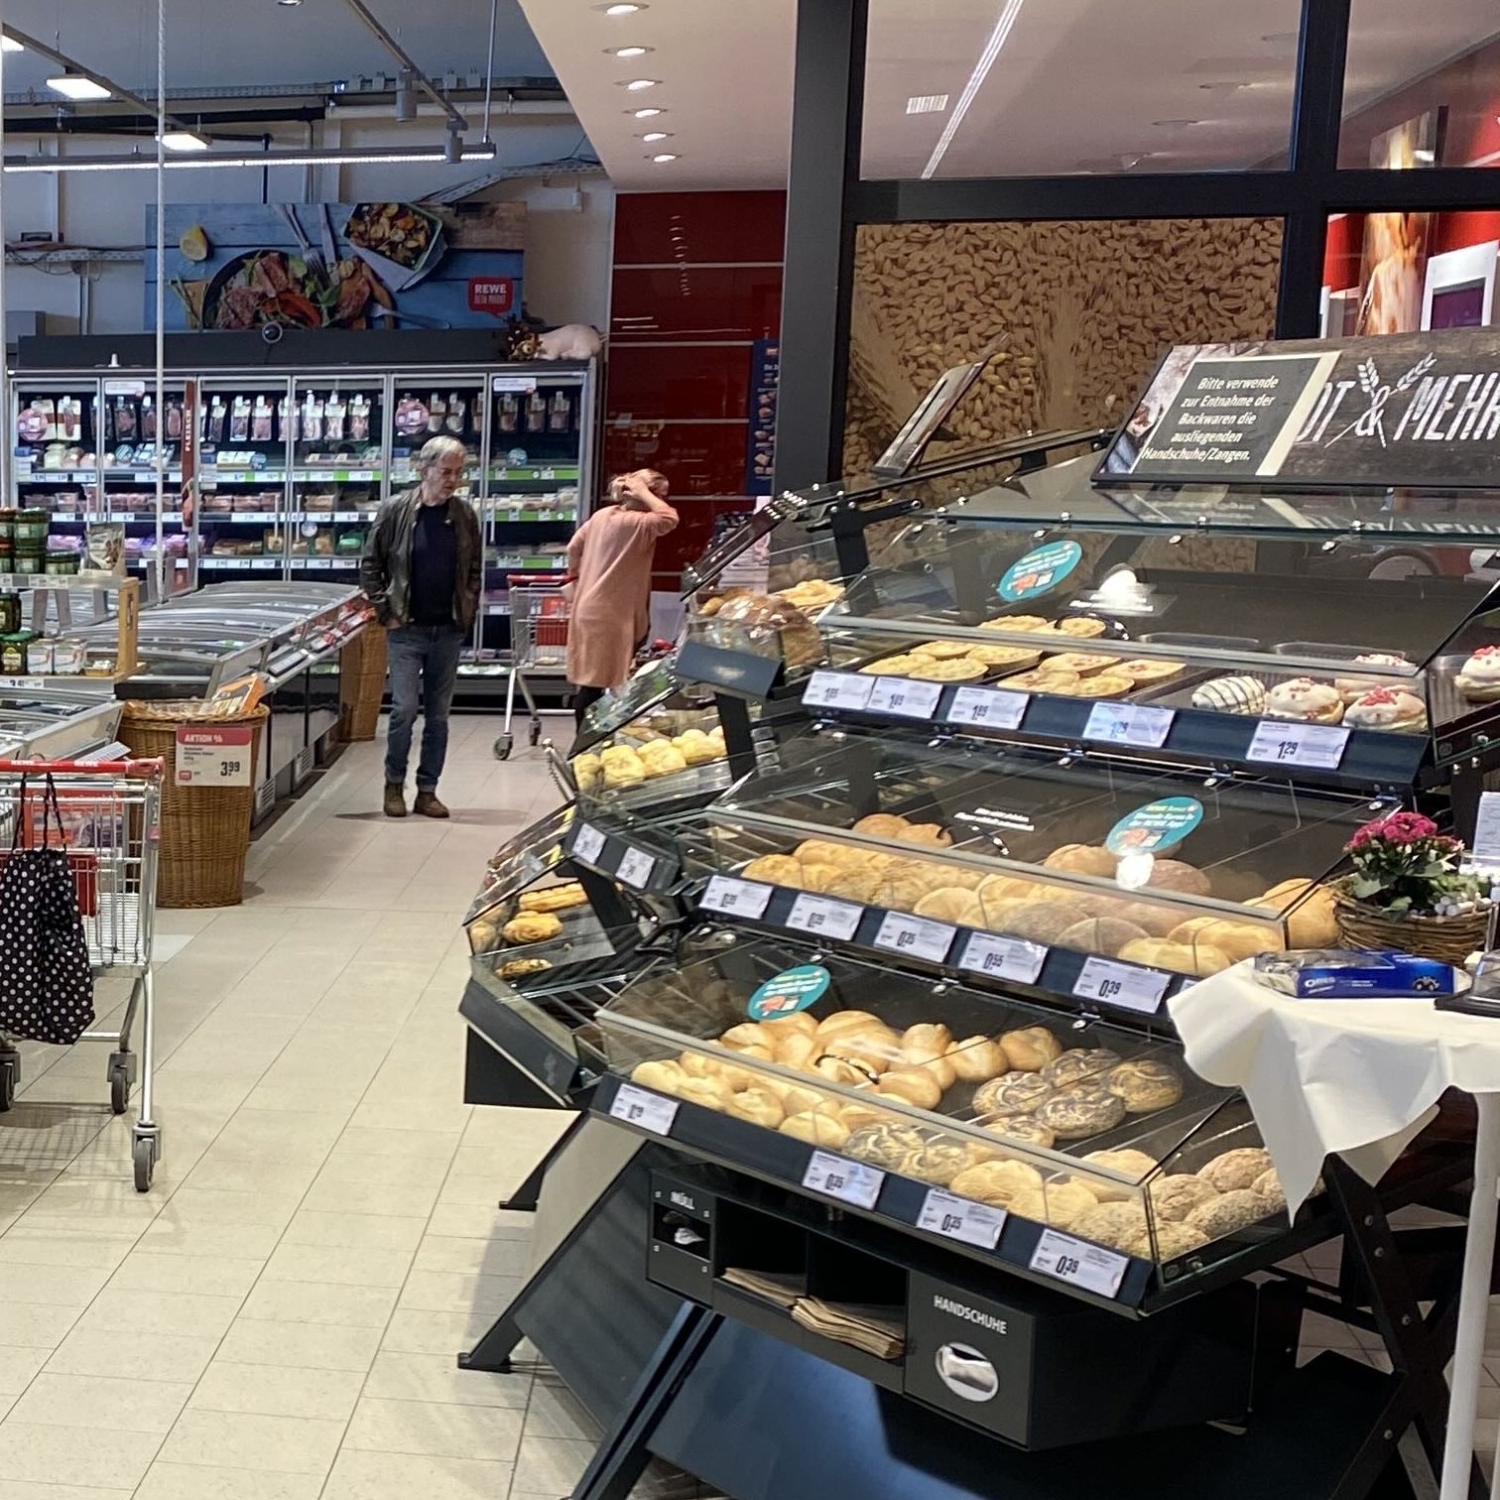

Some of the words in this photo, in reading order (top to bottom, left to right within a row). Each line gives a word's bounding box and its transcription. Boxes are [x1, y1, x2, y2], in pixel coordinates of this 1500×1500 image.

[475, 284, 506, 294] REWE
[1197, 377, 1222, 390] Bitte
[1225, 375, 1279, 389] verwende
[1181, 397, 1200, 408] zur
[1201, 395, 1253, 408] Entnahme
[1254, 393, 1276, 406] der
[1178, 412, 1236, 426] Backwaren
[1237, 411, 1257, 425] die
[1171, 430, 1243, 445] ausliegenden
[1141, 447, 1251, 464] Handschuhe/Zangen.
[184, 734, 212, 743] AKTION
[1277, 741, 1299, 760] 1.29
[220, 761, 241, 777] 3.99
[1099, 978, 1122, 998] 0.39
[933, 1295, 1008, 1335] HANDSCHUHE
